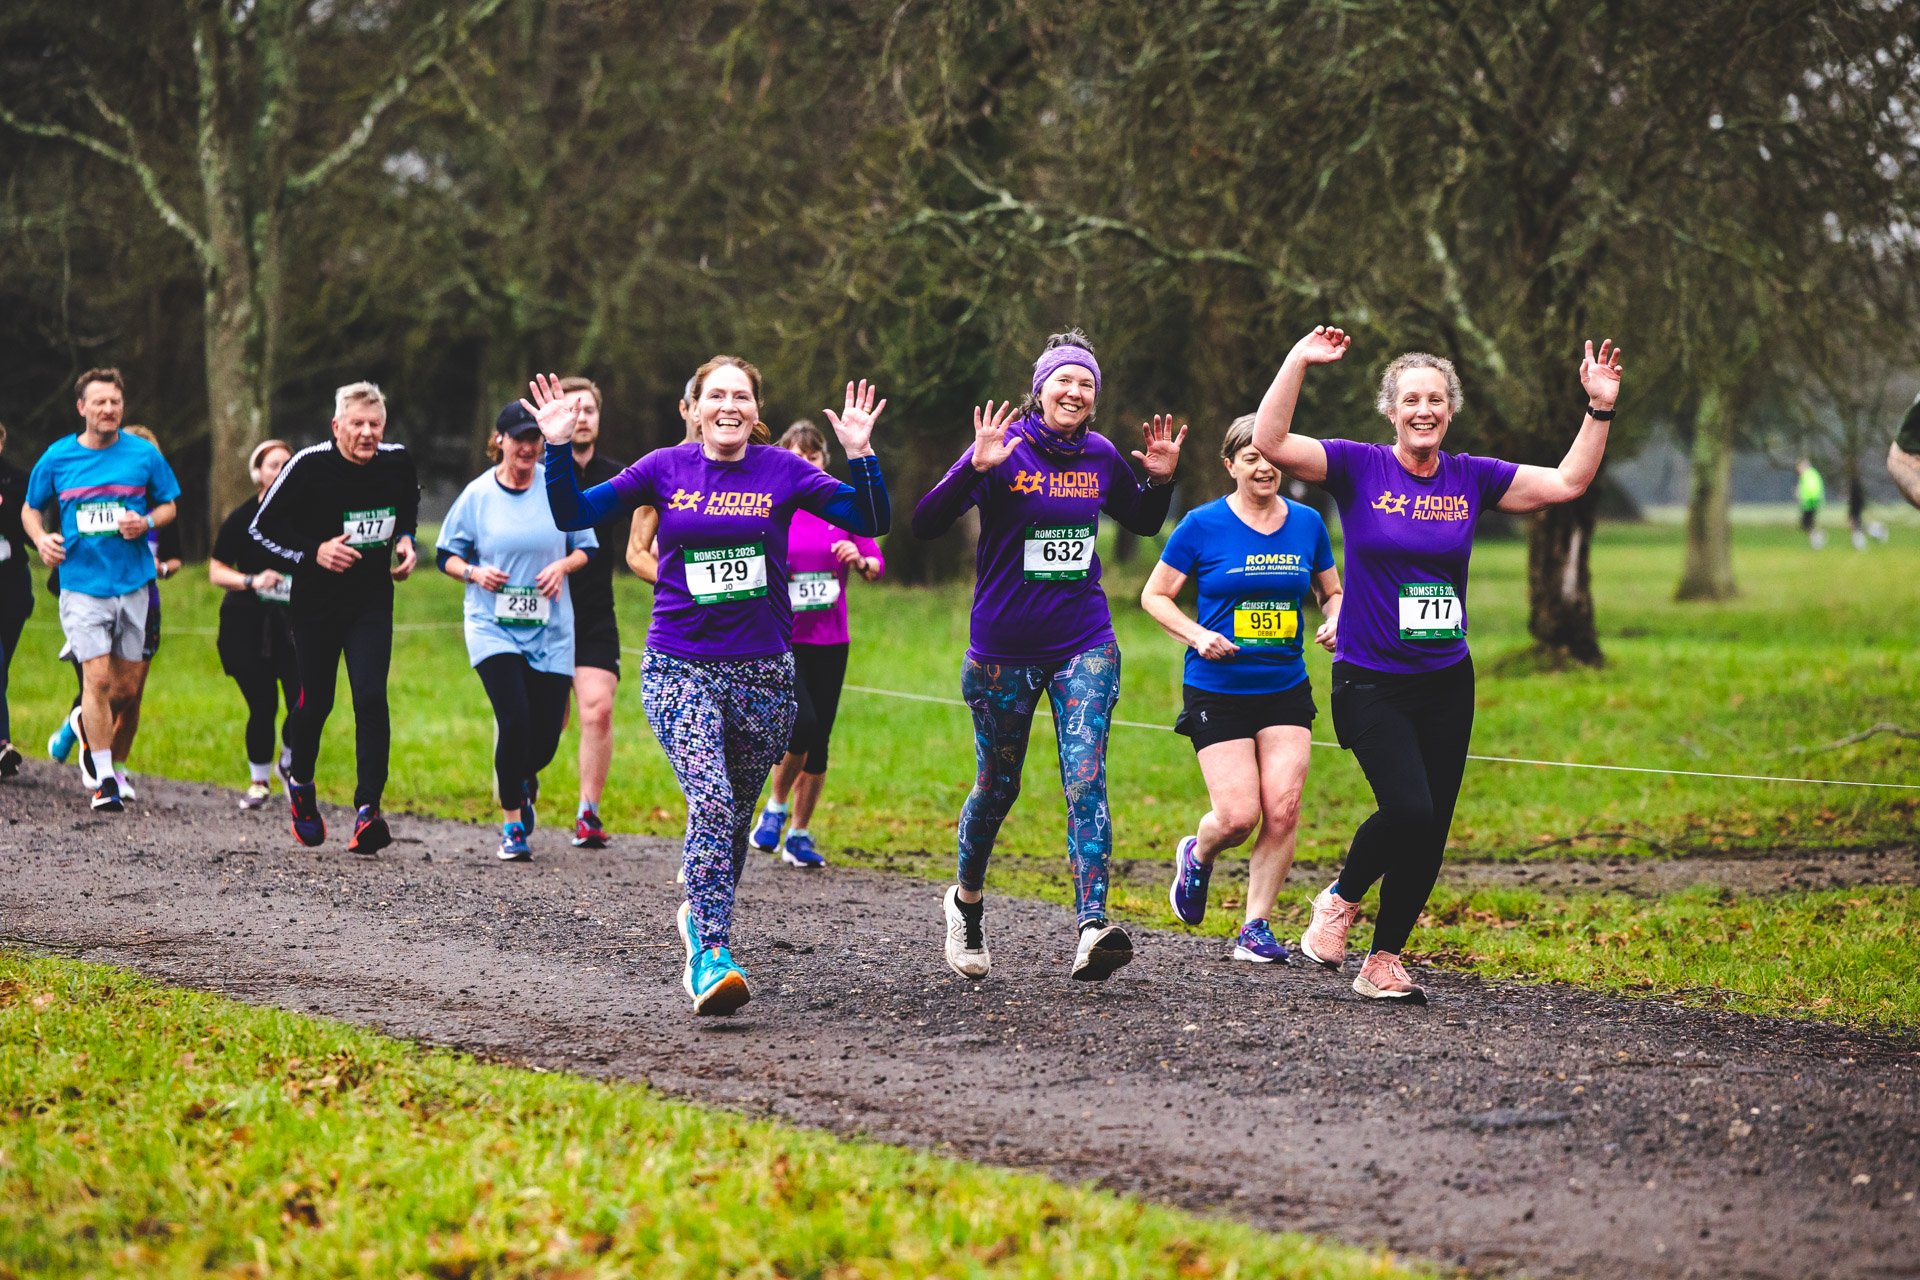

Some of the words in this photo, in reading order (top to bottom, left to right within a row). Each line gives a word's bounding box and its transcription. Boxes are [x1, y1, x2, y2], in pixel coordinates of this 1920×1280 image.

[1050, 472, 1098, 488] HOOK
[707, 491, 773, 508] HOOK
[1049, 487, 1099, 498] RUNNERS
[1414, 494, 1469, 511] HOOK
[88, 511, 114, 524] 718
[703, 505, 770, 518] RUNNERS
[1411, 509, 1469, 521] RUNNERS
[357, 520, 384, 535] 477
[1034, 529, 1066, 538] ROMSEY
[1067, 529, 1073, 538] 5
[694, 549, 726, 562] ROMSEY
[728, 549, 734, 558] 5
[735, 547, 756, 558] 2026
[1043, 541, 1084, 562] 632
[1246, 554, 1301, 565] ROMSEY
[706, 560, 748, 583] 129
[724, 583, 733, 591] JO
[799, 583, 827, 598] 512
[1409, 586, 1438, 596] ROMSEY
[1440, 586, 1444, 595] 5
[508, 597, 537, 612] 238
[1418, 599, 1452, 619] 717
[1251, 612, 1281, 630] 951
